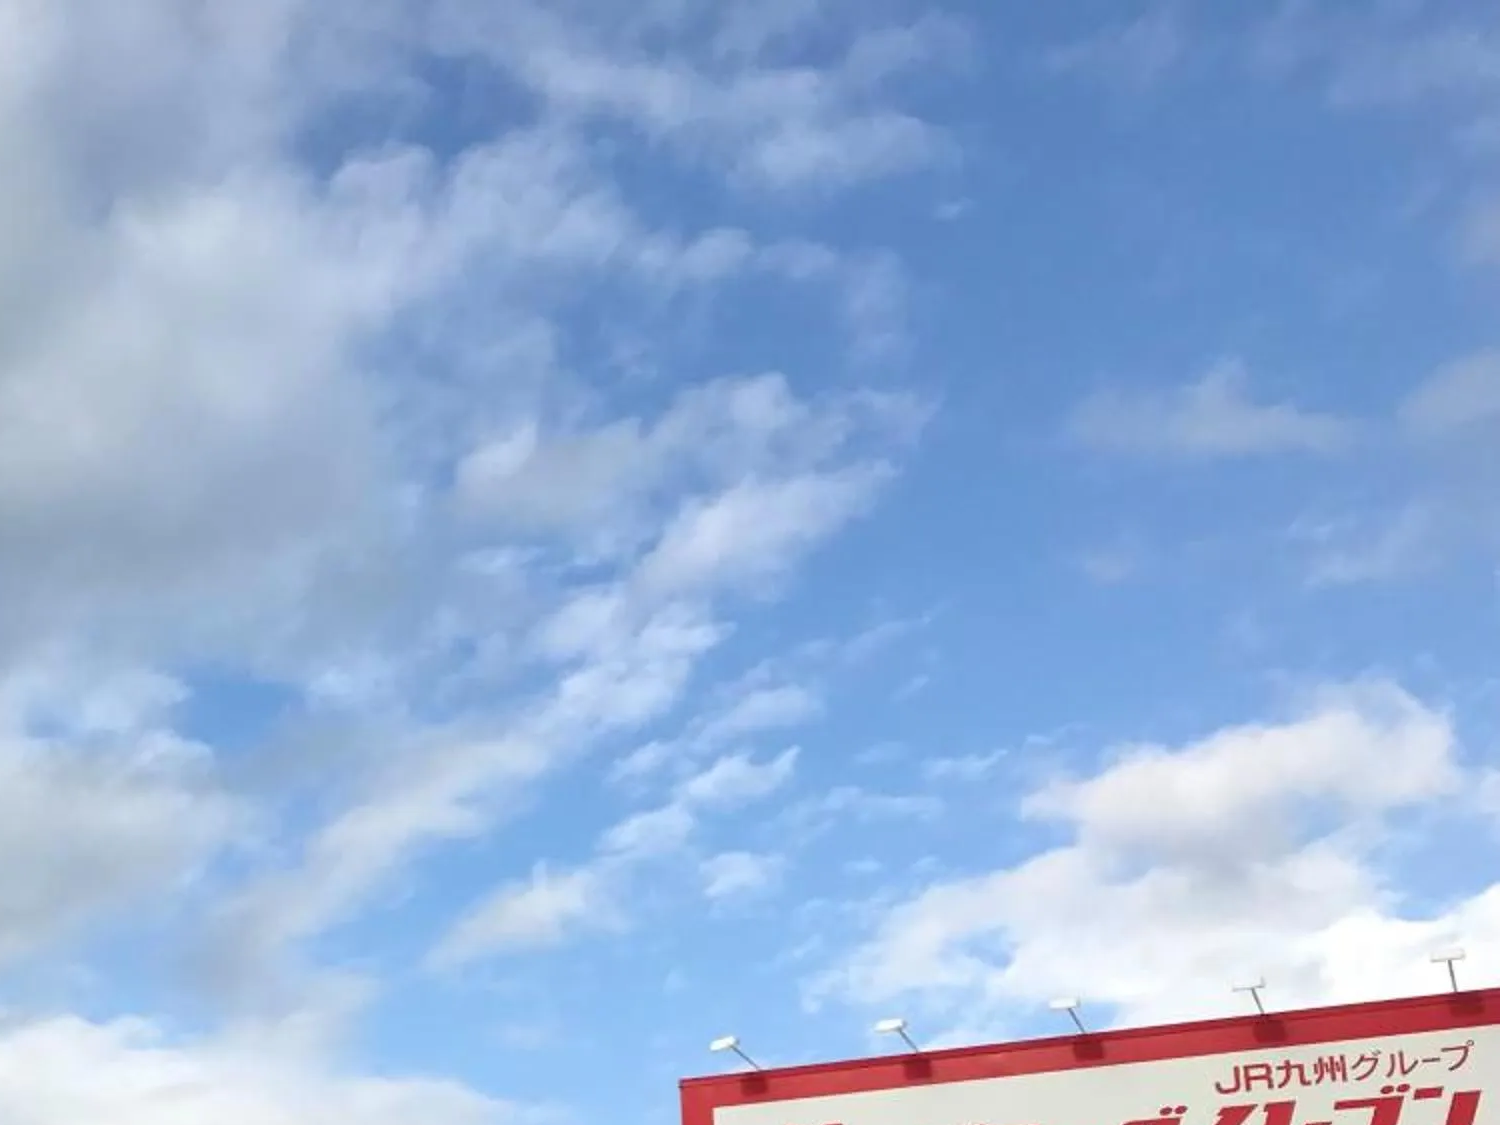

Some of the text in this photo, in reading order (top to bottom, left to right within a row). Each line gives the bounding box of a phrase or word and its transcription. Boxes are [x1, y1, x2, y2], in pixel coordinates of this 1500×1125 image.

[1214, 1039, 1475, 1095] JR九州グループ
